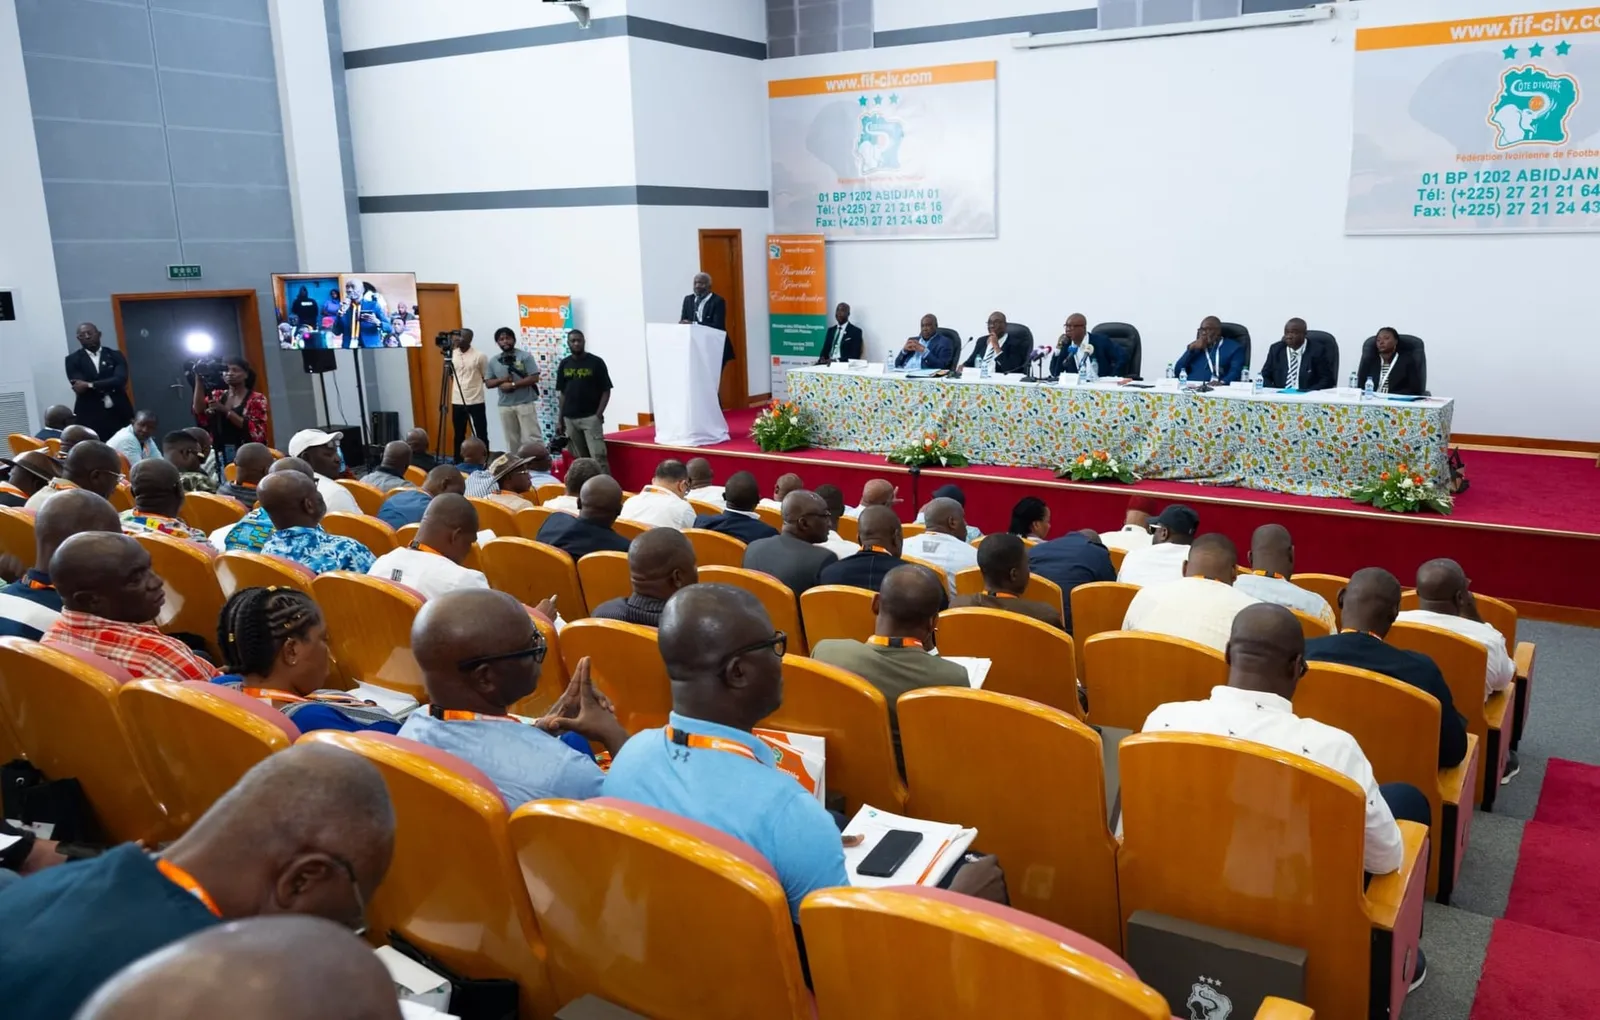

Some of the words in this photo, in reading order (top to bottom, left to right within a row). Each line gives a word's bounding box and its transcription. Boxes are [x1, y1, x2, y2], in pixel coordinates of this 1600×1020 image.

[1505, 151, 1550, 161] Ivoirienne
[1552, 150, 1564, 159] de
[1422, 172, 1439, 185] 01
[1445, 171, 1468, 185] BP
[1473, 170, 1511, 184] 1202
[1516, 167, 1600, 182] ABIDJAN
[818, 192, 829, 203] 01
[832, 192, 847, 202] BP
[849, 191, 872, 201] 1202
[875, 189, 924, 200] ABIDJAN
[927, 188, 940, 199] 01
[1416, 188, 1446, 201] Tél:
[1451, 186, 1500, 203] (+225)
[1505, 186, 1526, 199] 27
[1529, 185, 1549, 198] 21
[1555, 184, 1574, 198] 21
[1580, 184, 1600, 197] 64
[837, 203, 867, 216] (+225)
[870, 203, 882, 213] 27
[884, 202, 896, 213] 21
[899, 202, 911, 212] 21
[930, 201, 942, 211] 16
[1413, 204, 1447, 217] Fax:
[1451, 202, 1501, 219] (+225)
[1506, 202, 1526, 215] 27
[1530, 202, 1549, 215] 21
[1555, 201, 1576, 215] 24
[1580, 200, 1600, 214] 43
[815, 217, 836, 228] Fax:
[838, 216, 869, 229] (+225)
[871, 216, 883, 226] 27
[886, 215, 898, 226] 21
[901, 215, 913, 225] 24
[915, 214, 928, 225] 43
